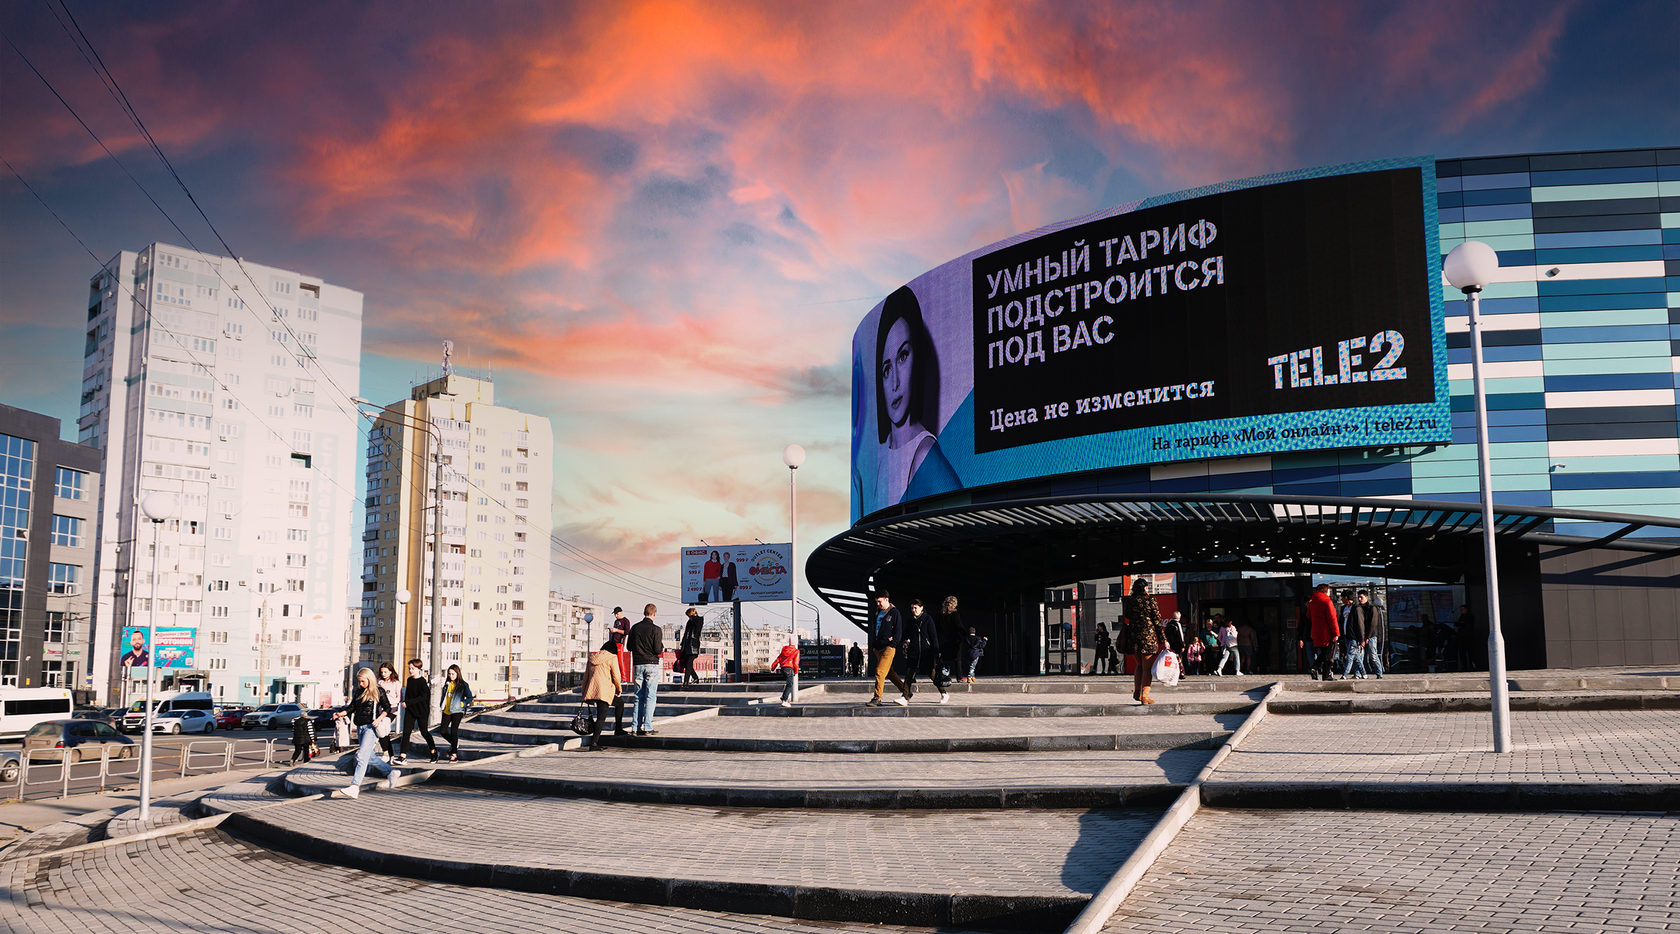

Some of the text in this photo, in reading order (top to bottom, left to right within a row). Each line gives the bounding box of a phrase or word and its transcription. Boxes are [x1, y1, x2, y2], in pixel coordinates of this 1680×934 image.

[986, 219, 1218, 299] УМНЫЙ ТАРИФ
[987, 255, 1224, 334] ПОДСТРОИТСЯ
[988, 315, 1115, 369] ПОД ВАС
[1267, 329, 1407, 390] TELE2
[989, 380, 1215, 432] Цена не изменится
[1152, 416, 1438, 451] На тарифе «Мой онлайн+» tele2.ru
[751, 549, 766, 562] OUTLET
[766, 548, 784, 560] CENTER
